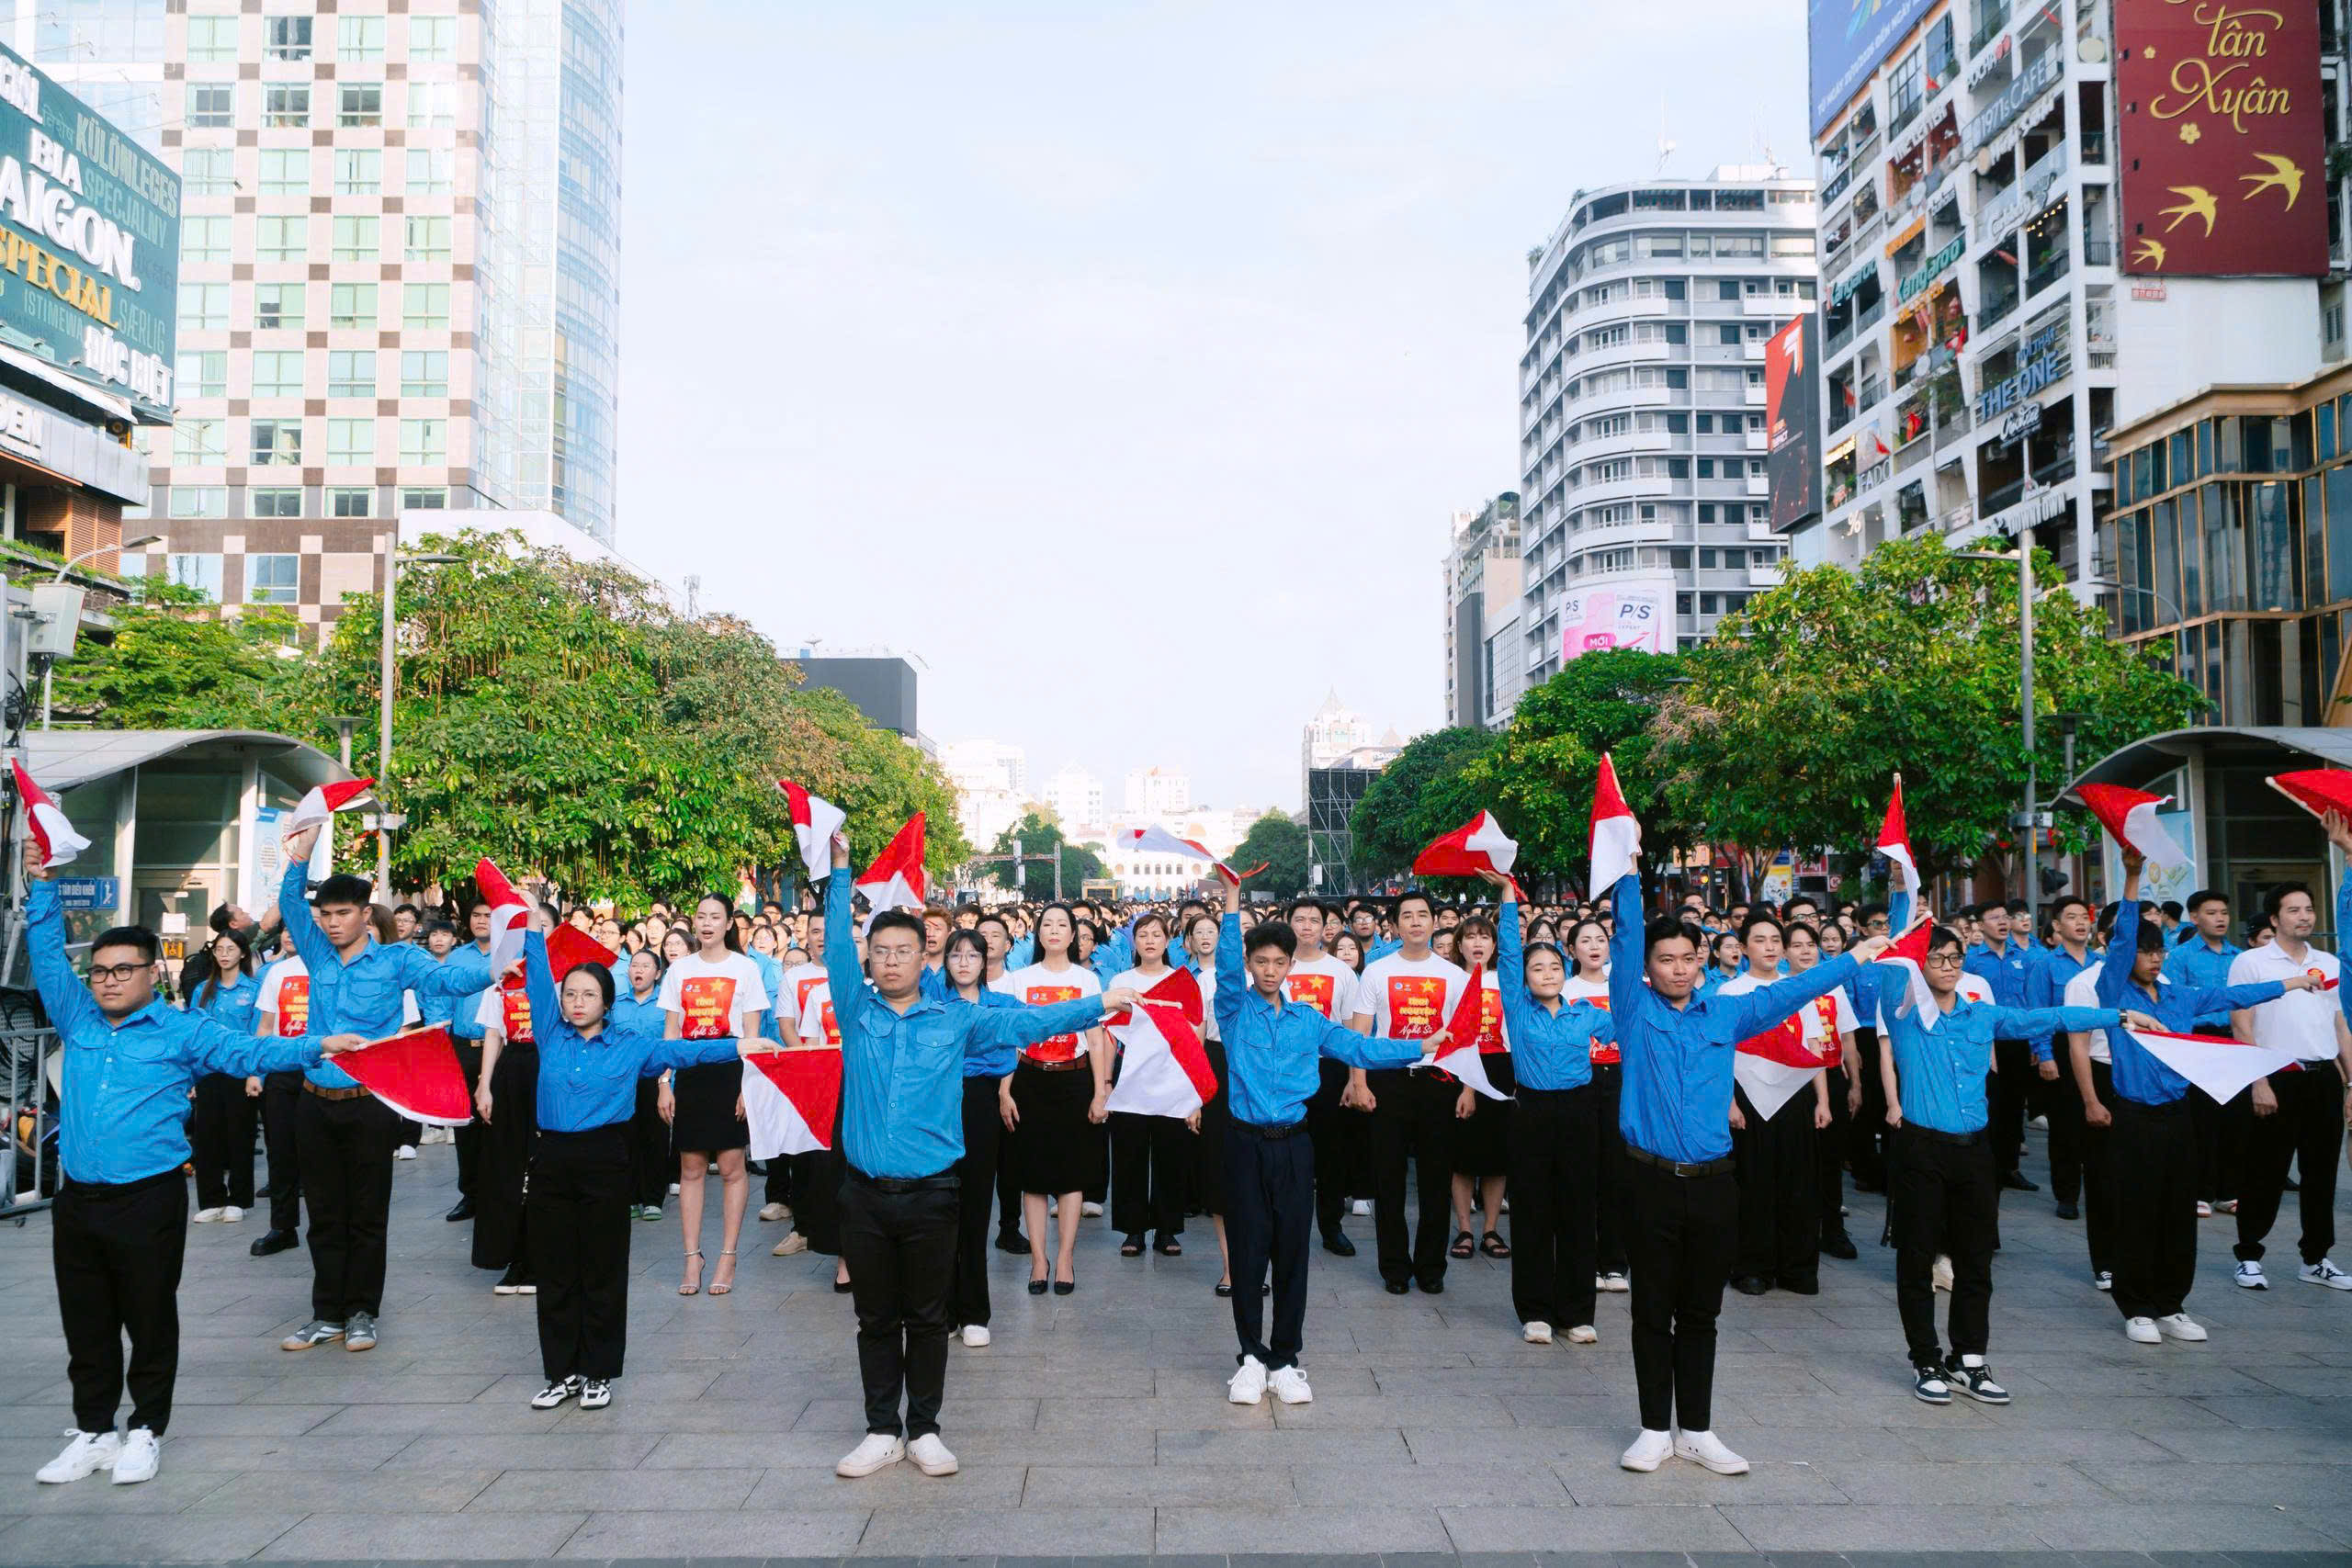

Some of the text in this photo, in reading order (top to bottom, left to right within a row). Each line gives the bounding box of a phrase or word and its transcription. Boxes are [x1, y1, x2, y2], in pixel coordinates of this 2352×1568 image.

[2193, 4, 2284, 59] tân
[2009, 56, 2046, 110] CAFE
[2149, 57, 2291, 134] Xuân
[30, 127, 85, 197] BIA
[85, 167, 167, 249] SPECJALNY
[1894, 239, 1961, 308] Kangaroo
[24, 288, 85, 344] ISTIMEWA
[118, 299, 165, 355] SÆRLIG
[85, 325, 129, 386] ĐẶC
[130, 348, 174, 408] BIỆT
[1980, 350, 2059, 421] THE ONE
[1860, 459, 1890, 493] FADO
[2008, 491, 2066, 537] DOWNTOWN
[1619, 604, 1651, 620] P/S
